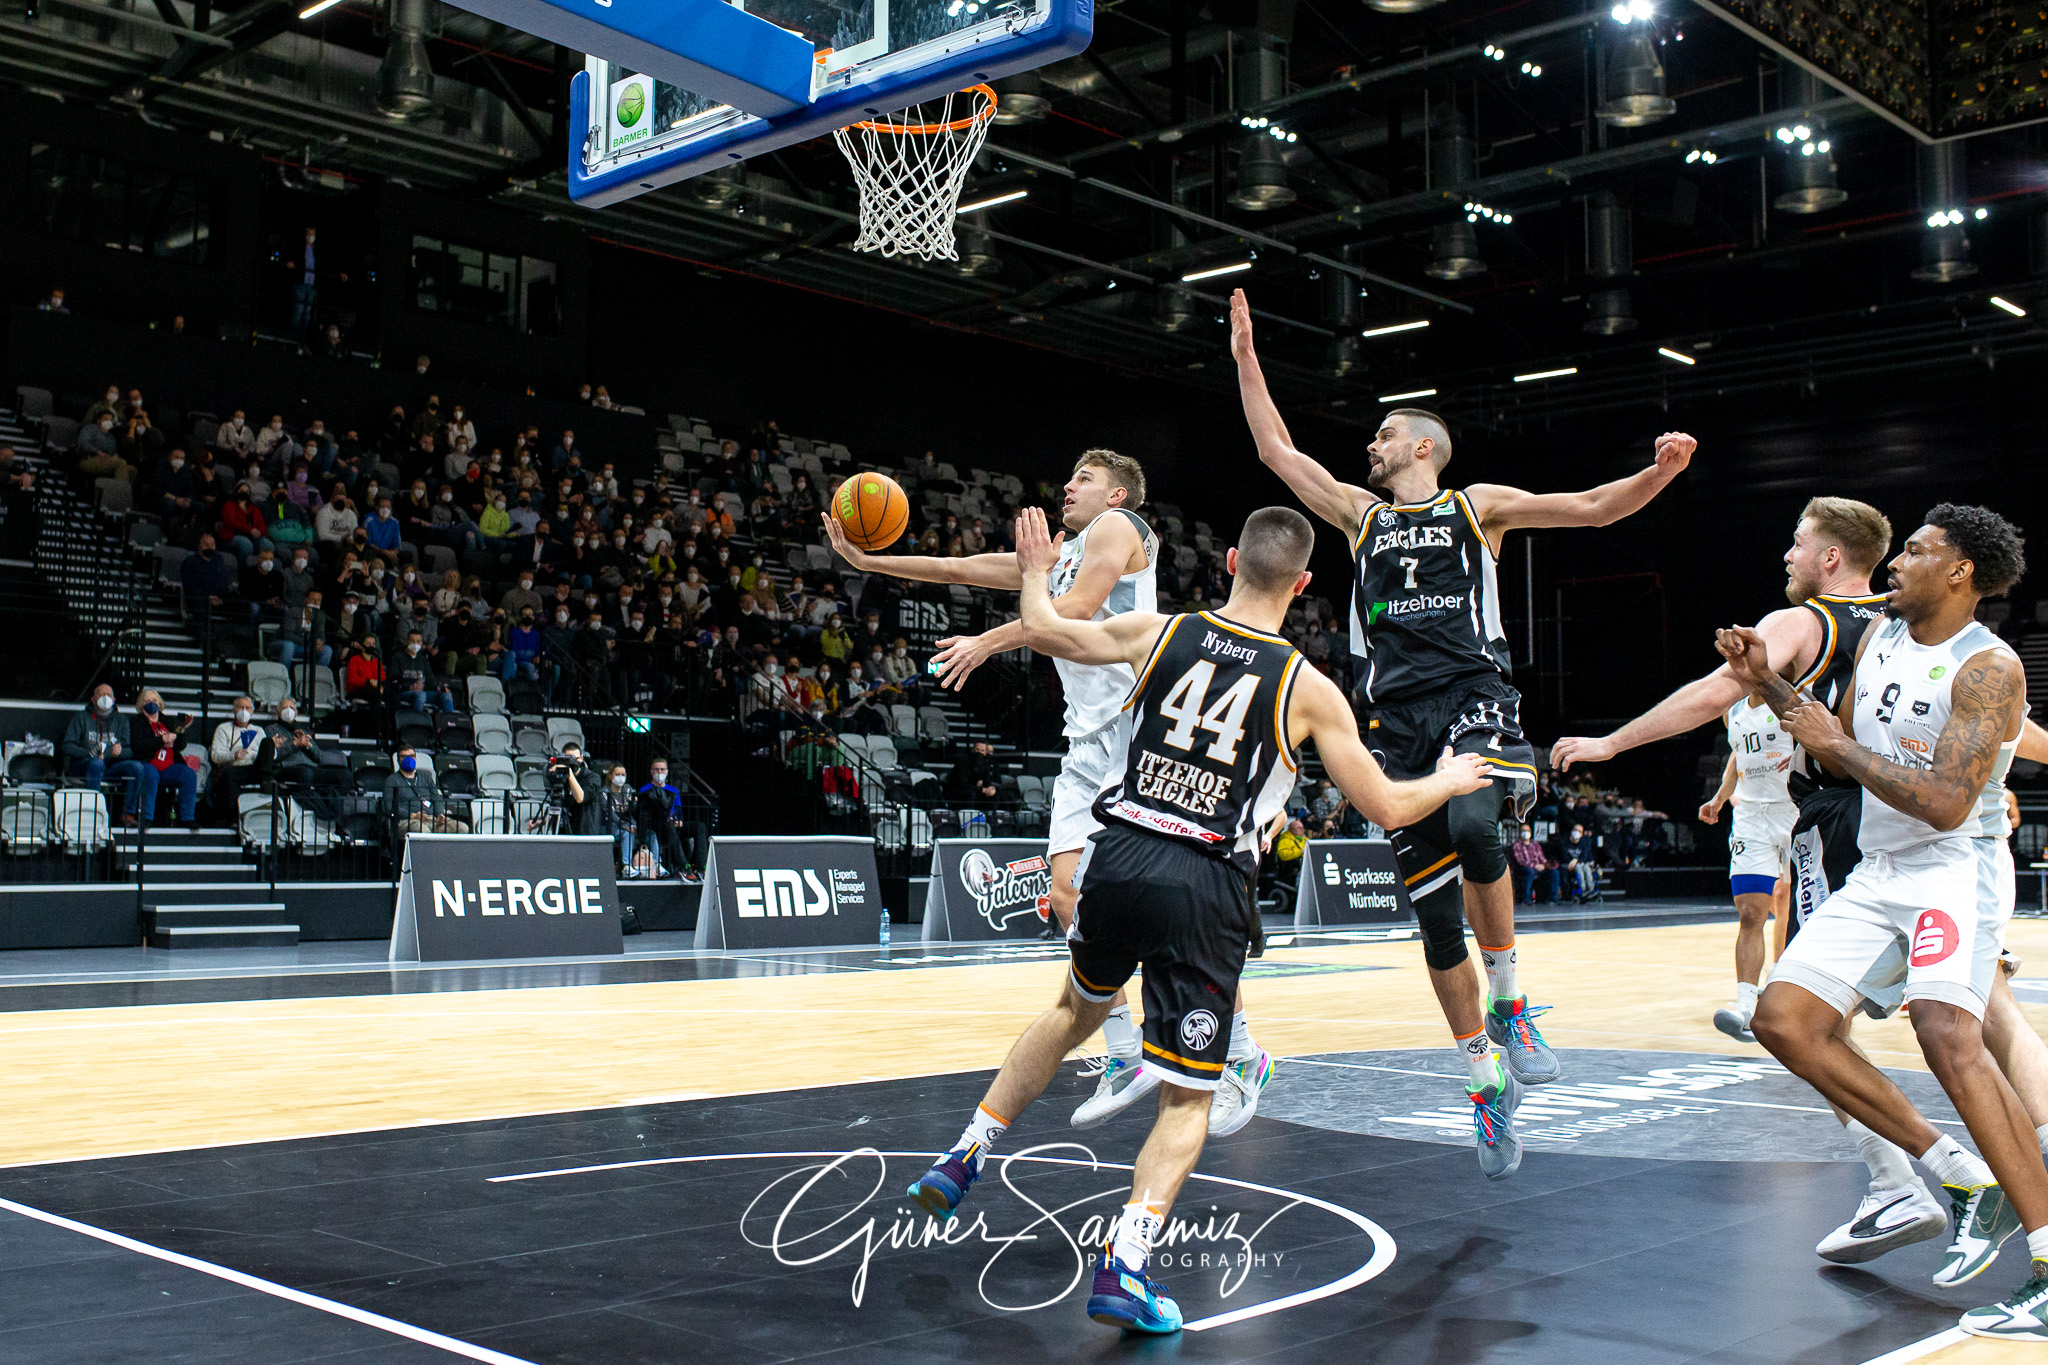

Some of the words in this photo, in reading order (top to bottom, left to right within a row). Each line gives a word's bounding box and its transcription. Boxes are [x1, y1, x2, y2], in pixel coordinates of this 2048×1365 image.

[613, 128, 649, 148] BARMER
[1371, 526, 1452, 557] EAGLES
[1399, 557, 1418, 589] 7
[1388, 595, 1464, 615] Itzehoer
[1201, 630, 1258, 665] Nyberg
[1160, 659, 1262, 766] 44
[1876, 682, 1900, 724] 9
[1742, 732, 1762, 754] 10
[1900, 736, 1929, 752] EMS
[1136, 749, 1232, 800] ITZEHOE
[1137, 772, 1218, 817] EAGLES
[834, 869, 857, 881] Experts
[836, 882, 865, 893] Managed
[1344, 868, 1395, 888] Sparkasse
[734, 868, 830, 918] EMS
[837, 894, 864, 904] Services
[979, 869, 1050, 914] Falcons
[1348, 891, 1397, 912] Nürnberg
